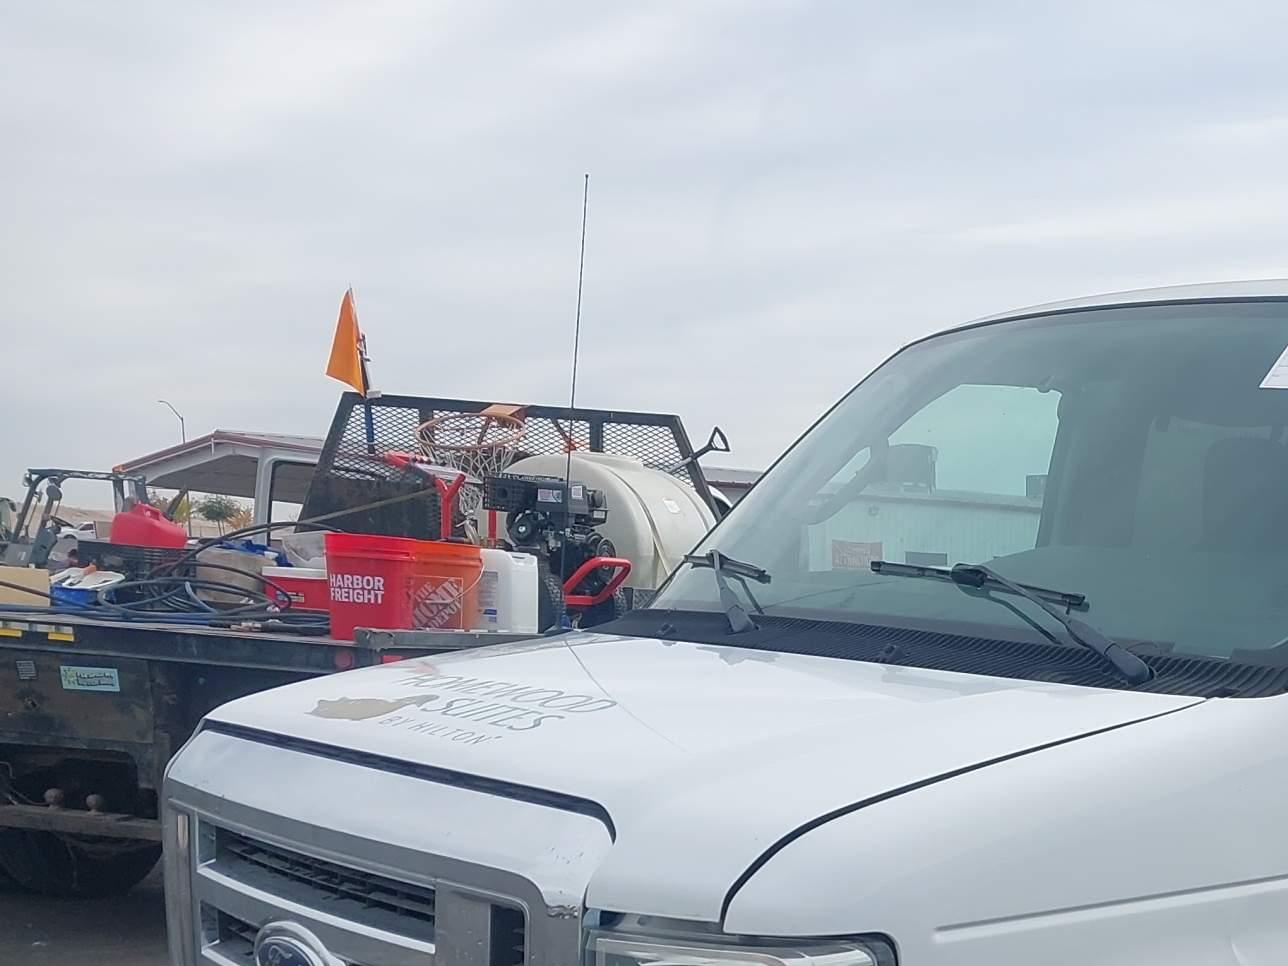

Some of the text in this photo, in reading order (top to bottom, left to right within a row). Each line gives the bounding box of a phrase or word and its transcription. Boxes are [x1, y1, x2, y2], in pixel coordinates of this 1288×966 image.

[329, 573, 385, 591] HARBOR
[329, 588, 385, 604] FREIGHT
[396, 674, 618, 713] HOMEWOOD
[378, 715, 414, 729] BY
[420, 698, 566, 731] SUITES
